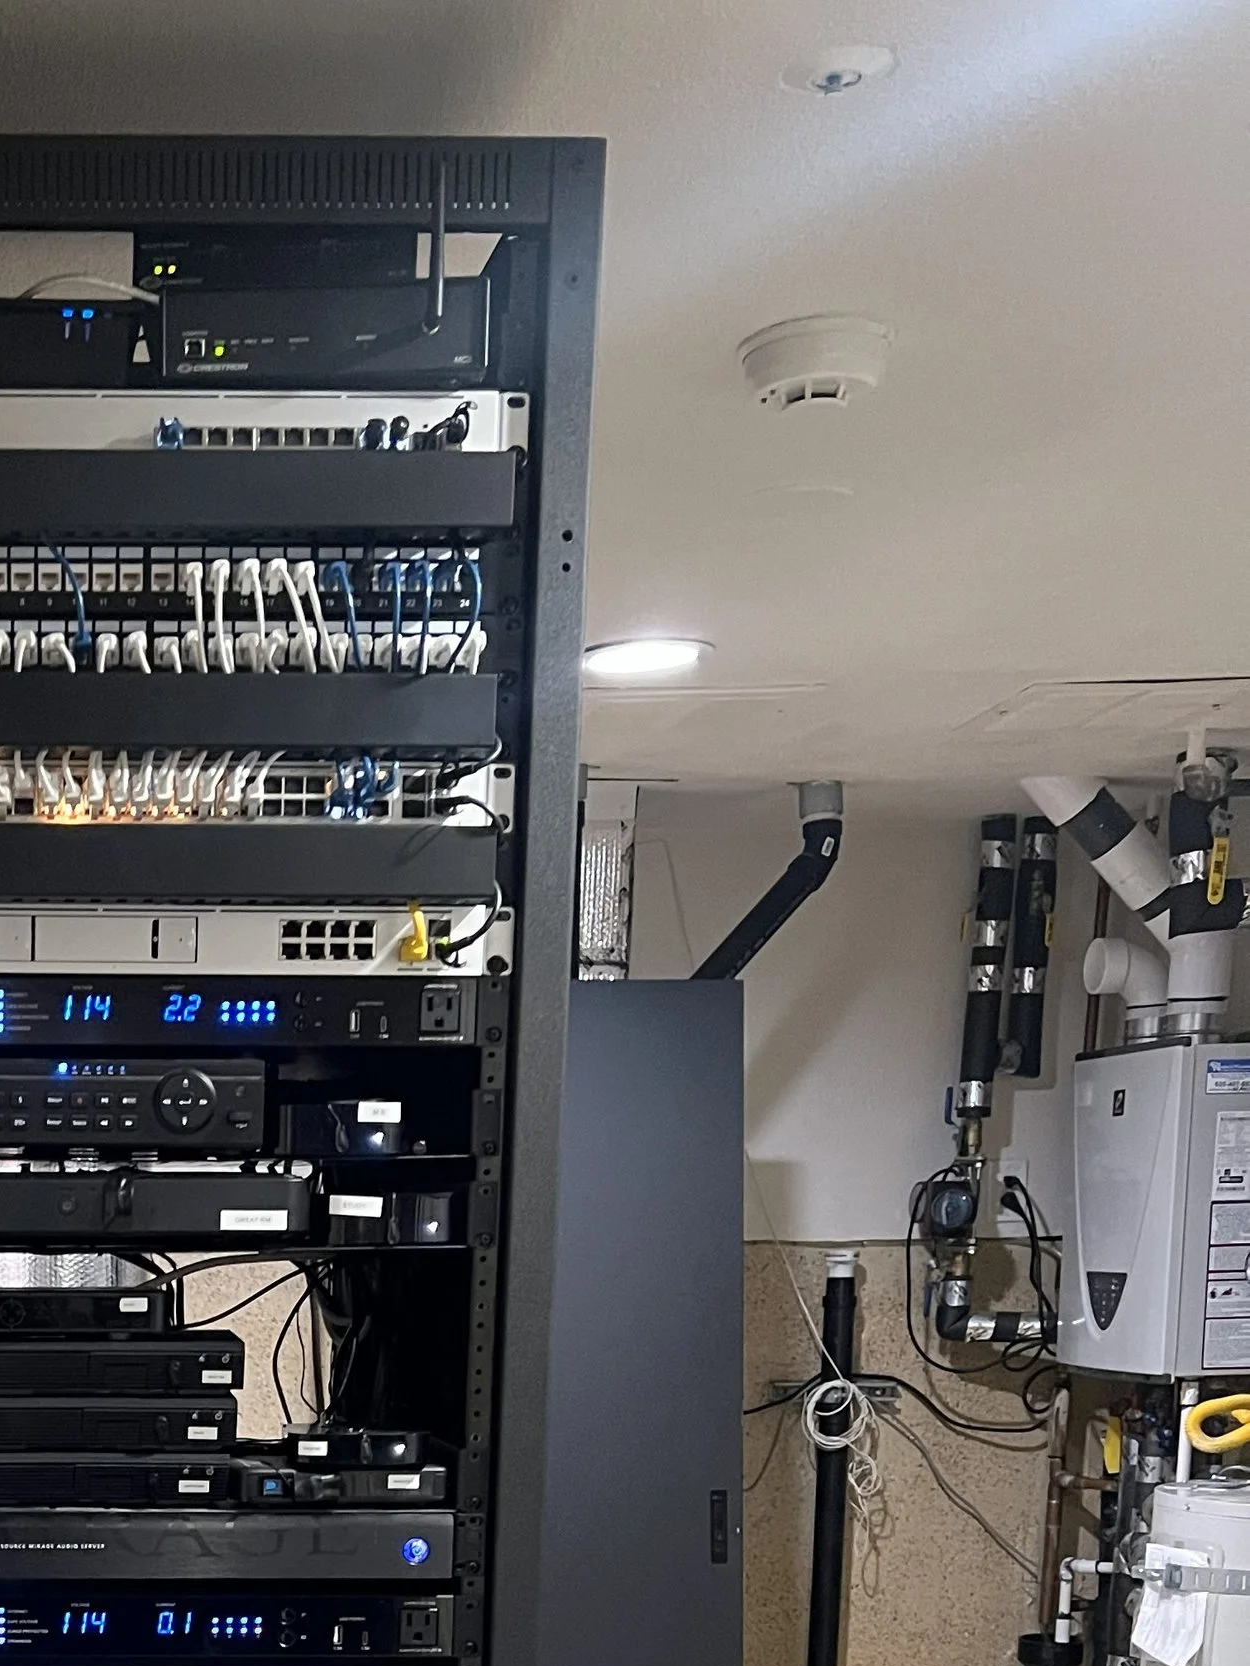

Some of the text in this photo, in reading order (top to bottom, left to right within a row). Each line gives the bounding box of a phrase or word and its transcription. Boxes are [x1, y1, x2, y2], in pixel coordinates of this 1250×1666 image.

[459, 599, 470, 608] 24
[64, 994, 112, 1021] 114
[163, 994, 201, 1022] 2.2
[63, 1612, 106, 1634] 114
[157, 1611, 192, 1634] 0.1
